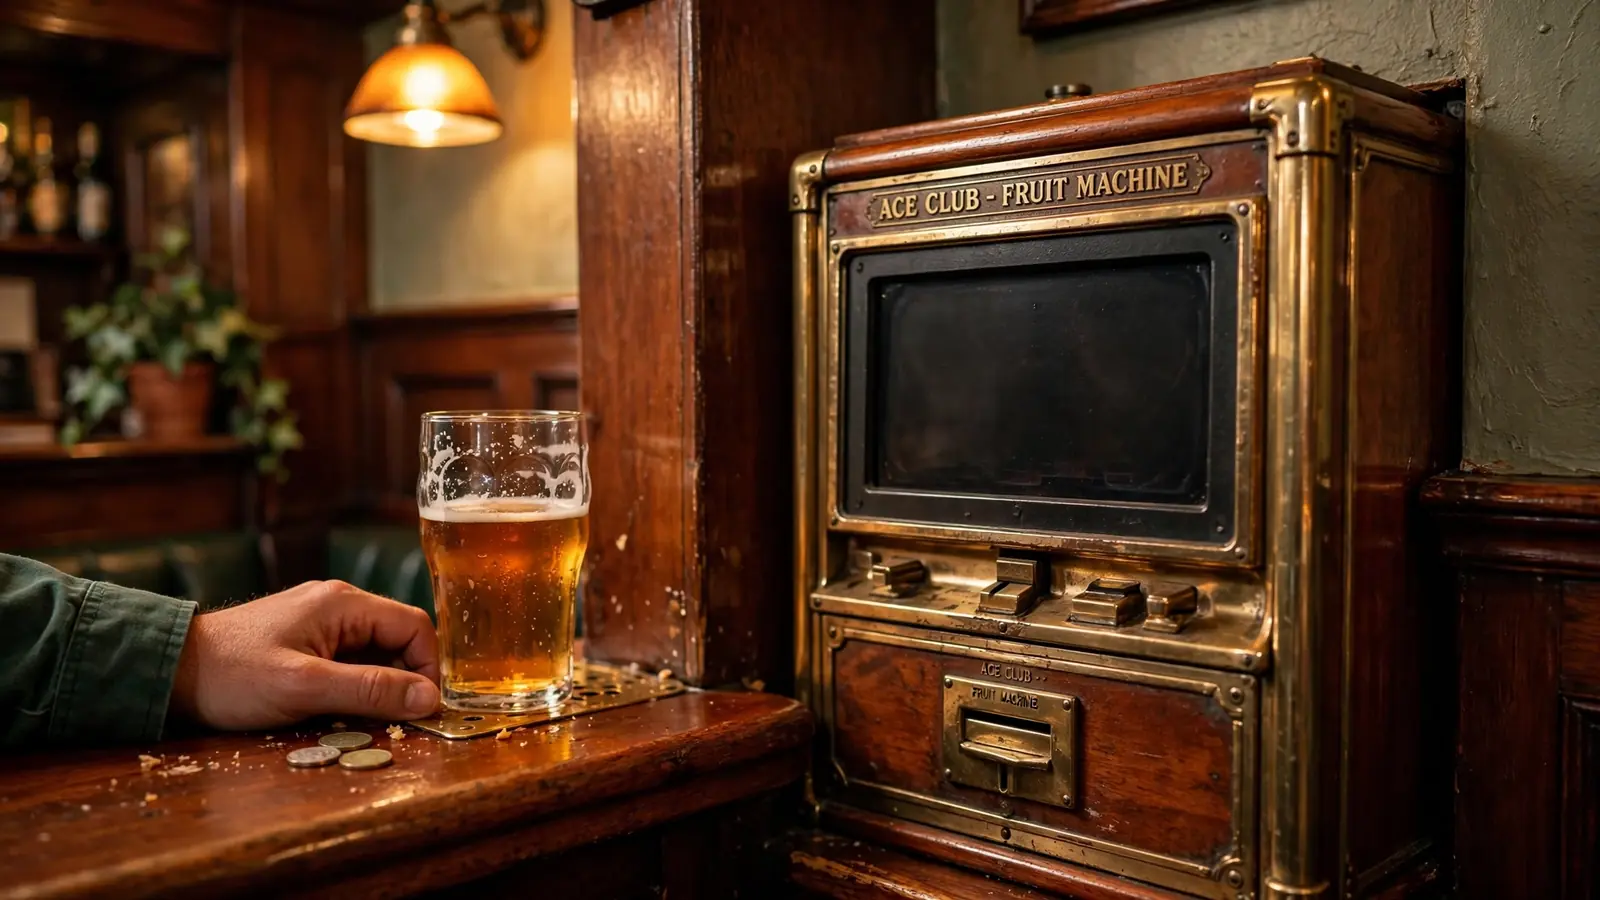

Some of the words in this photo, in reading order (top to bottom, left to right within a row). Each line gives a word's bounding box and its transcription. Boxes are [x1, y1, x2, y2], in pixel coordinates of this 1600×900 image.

[879, 194, 918, 221] ACE
[924, 187, 980, 215] CLUB
[1001, 176, 1068, 207] FRUIT
[1076, 162, 1189, 199] MACHINE
[980, 661, 1001, 677] ACE
[1004, 666, 1032, 682] CLUB
[971, 686, 996, 701] FRUIT
